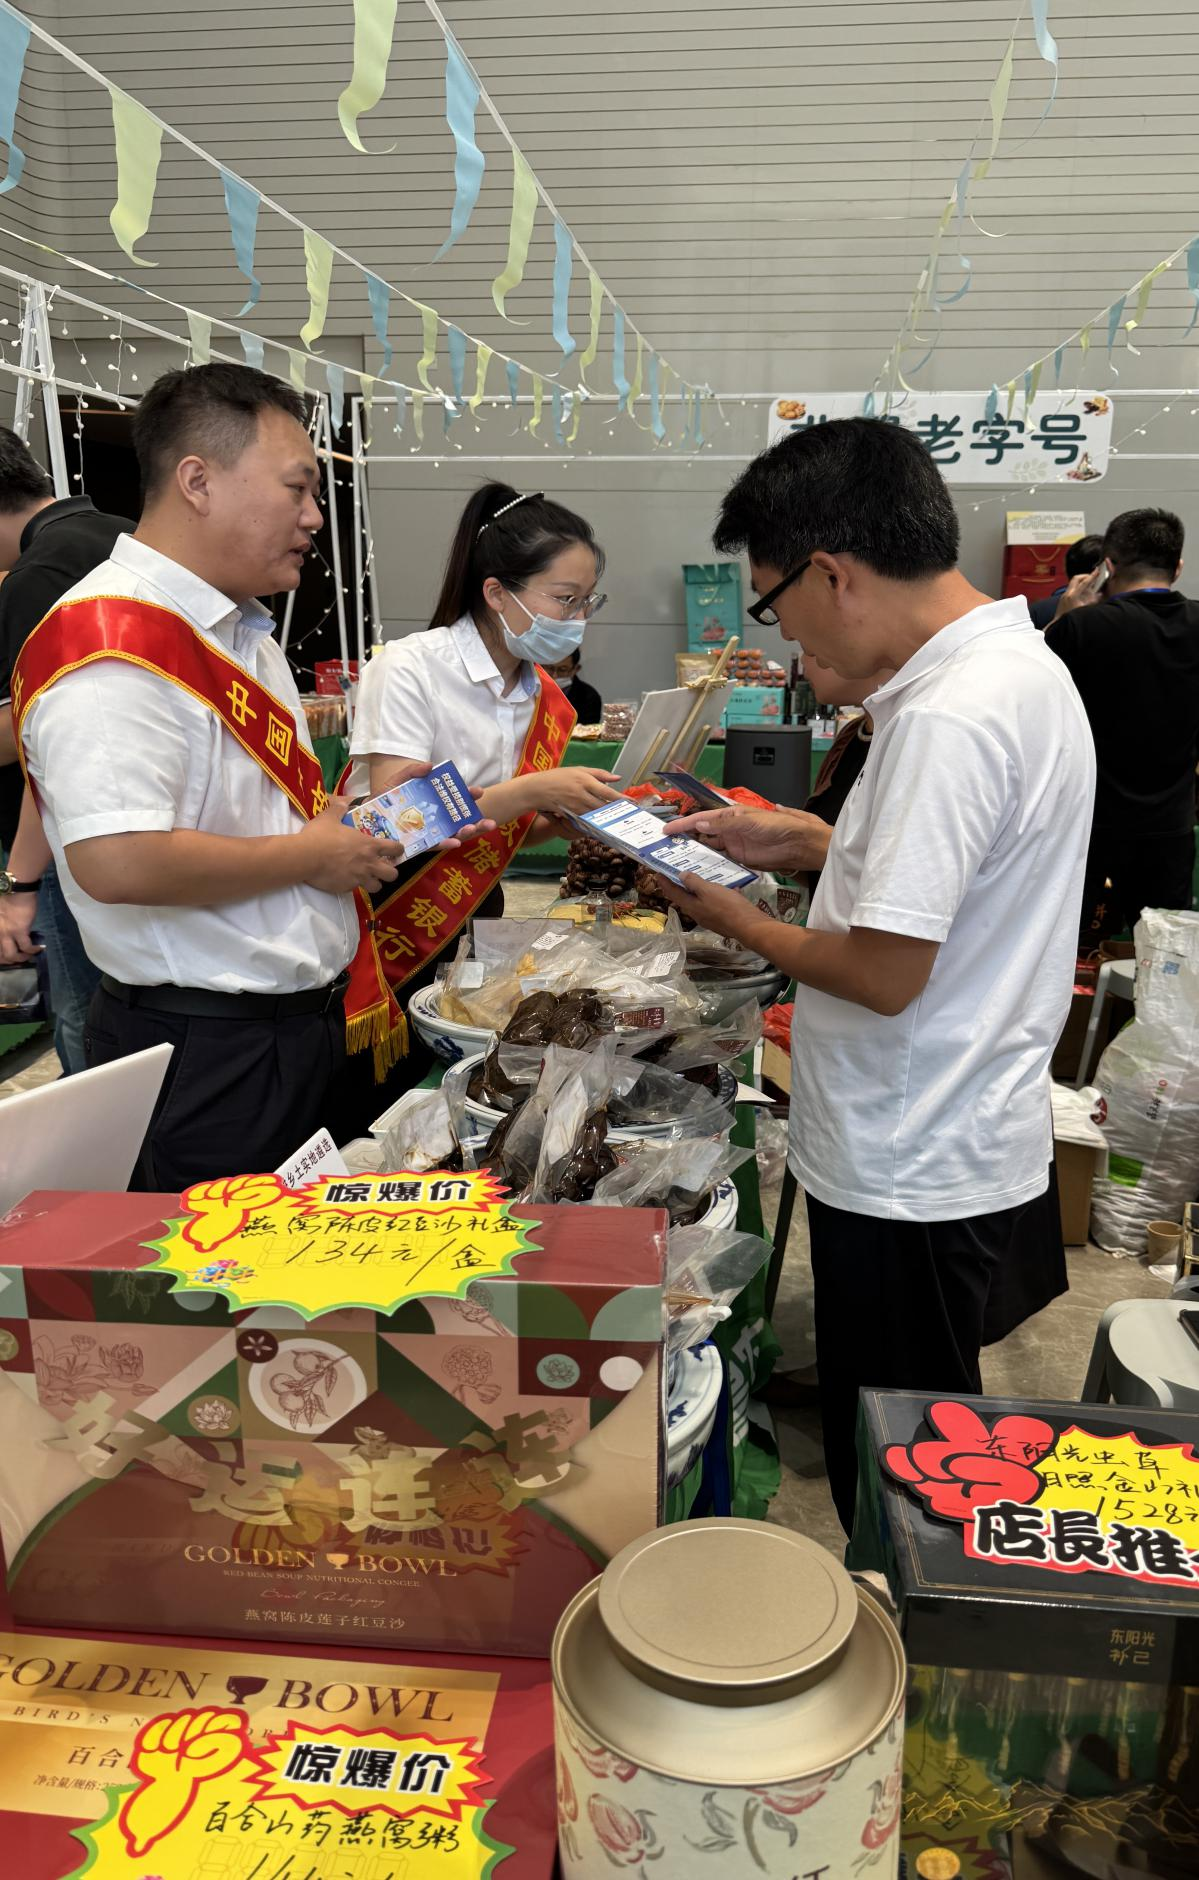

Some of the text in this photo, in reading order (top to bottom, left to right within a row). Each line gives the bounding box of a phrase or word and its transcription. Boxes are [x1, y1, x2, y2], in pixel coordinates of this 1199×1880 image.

[790, 413, 1087, 465] 老字号
[325, 1180, 472, 1202] 惊爆价
[975, 1501, 1199, 1578] 店長推
[184, 1544, 316, 1569] GOLDEN
[359, 1554, 458, 1577] BOWL
[223, 1569, 421, 1588] RED BEAN SOUP NUTRITIONAL CONGEE
[244, 1608, 406, 1630] 燕窝陈皮莲子红豆沙
[1110, 1629, 1156, 1647] 东阳光
[273, 1679, 454, 1722] BOWL
[67, 1745, 131, 1769] 百合
[285, 1744, 450, 1793] 惊爆价
